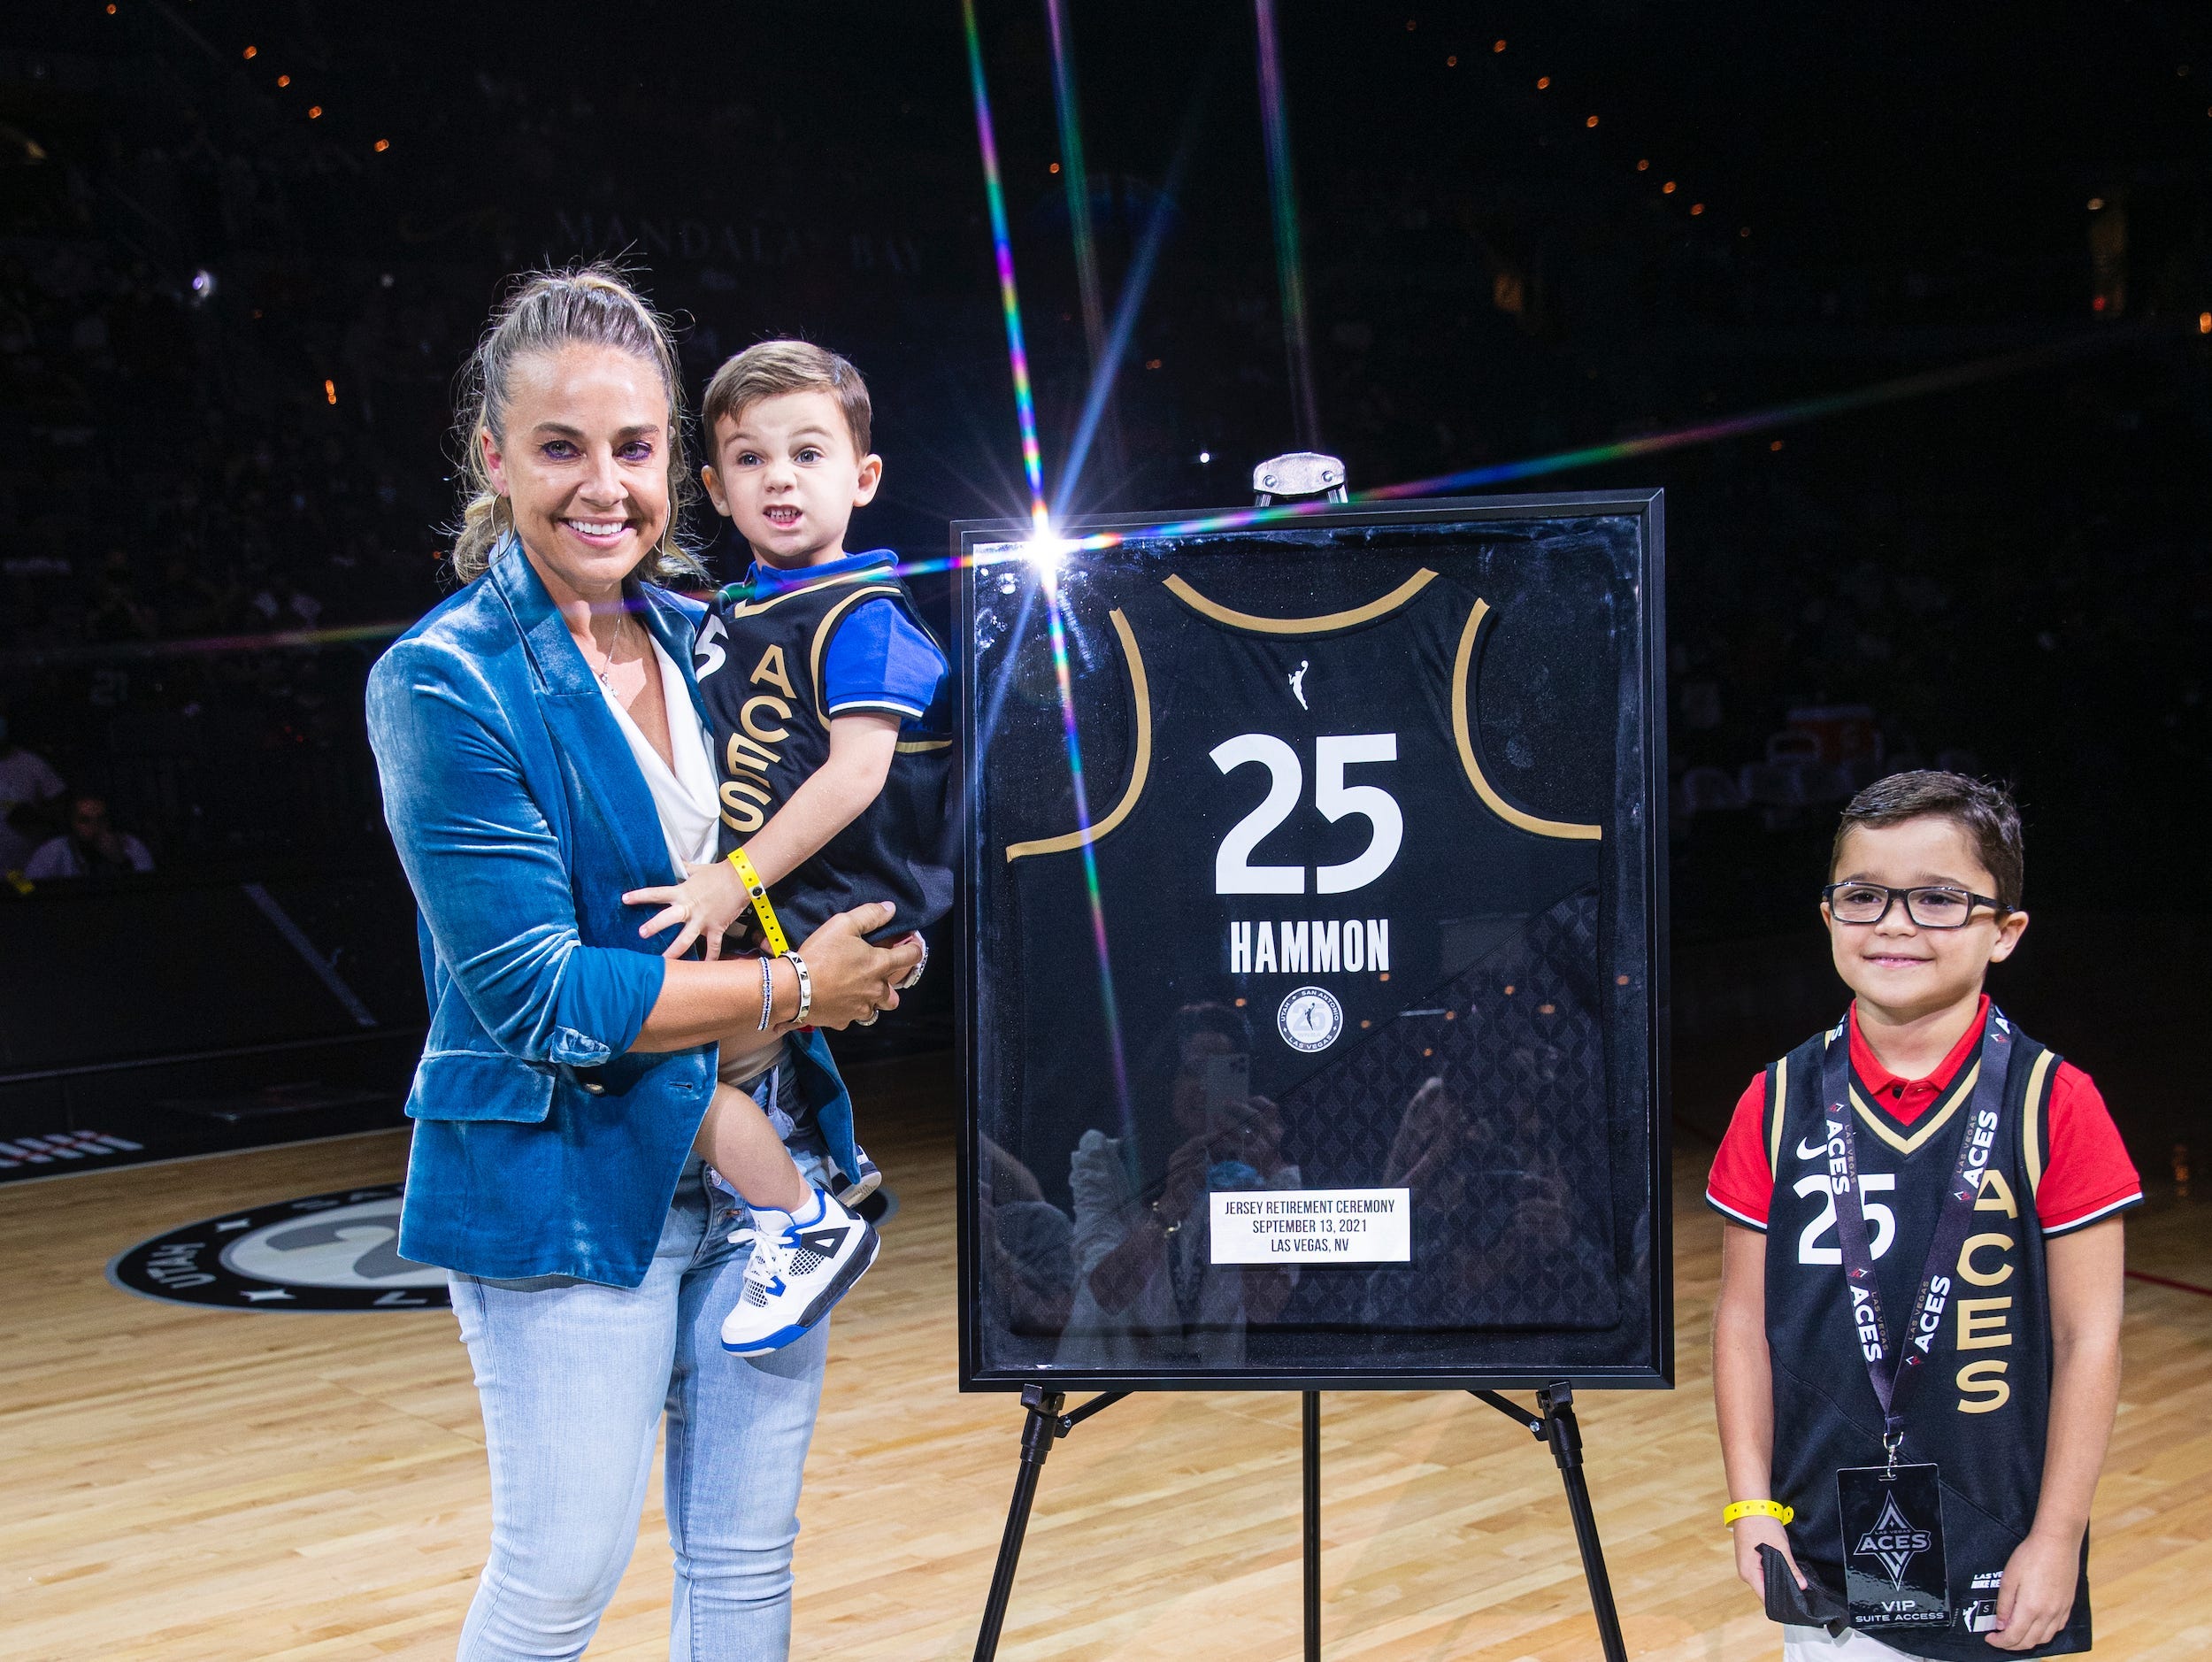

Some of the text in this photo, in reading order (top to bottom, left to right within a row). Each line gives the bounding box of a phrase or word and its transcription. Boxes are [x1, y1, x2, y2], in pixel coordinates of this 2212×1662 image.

[719, 643, 796, 832] ACES
[1209, 733, 1404, 895] 25
[1231, 919, 1389, 973] HAMMON
[1280, 1002, 1290, 1021] UTAH
[1318, 991, 1340, 1021] ANTONIO
[1288, 1036, 1304, 1049] LAS
[1306, 1034, 1333, 1050] VEGAS
[1826, 1120, 1851, 1196] ACES
[1847, 1149, 1856, 1184] VEGAS
[1955, 1115, 1977, 1174] LAS VEGAS
[1962, 1109, 1998, 1189] ACES
[1225, 1199, 1395, 1215] JERSEY RETIREMENT CEREMONY
[1252, 1219, 1367, 1235] SEPTEMBER 13, 2021
[1793, 1173, 1896, 1266] 25
[1271, 1238, 1349, 1253] LAS VEGAS, NV
[1908, 1281, 1929, 1341] LAS VEGAS
[1914, 1274, 1951, 1354] ACES
[1956, 1169, 2018, 1413] ACES
[1850, 1285, 1883, 1363] ACES
[1871, 1292, 1889, 1351] LAS VEGAS
[1861, 1534, 1927, 1551] ACES
[1855, 1614, 1891, 1623] SUITE
[1894, 1612, 1944, 1621] ACCESS
[1881, 1600, 1916, 1612] VIP
